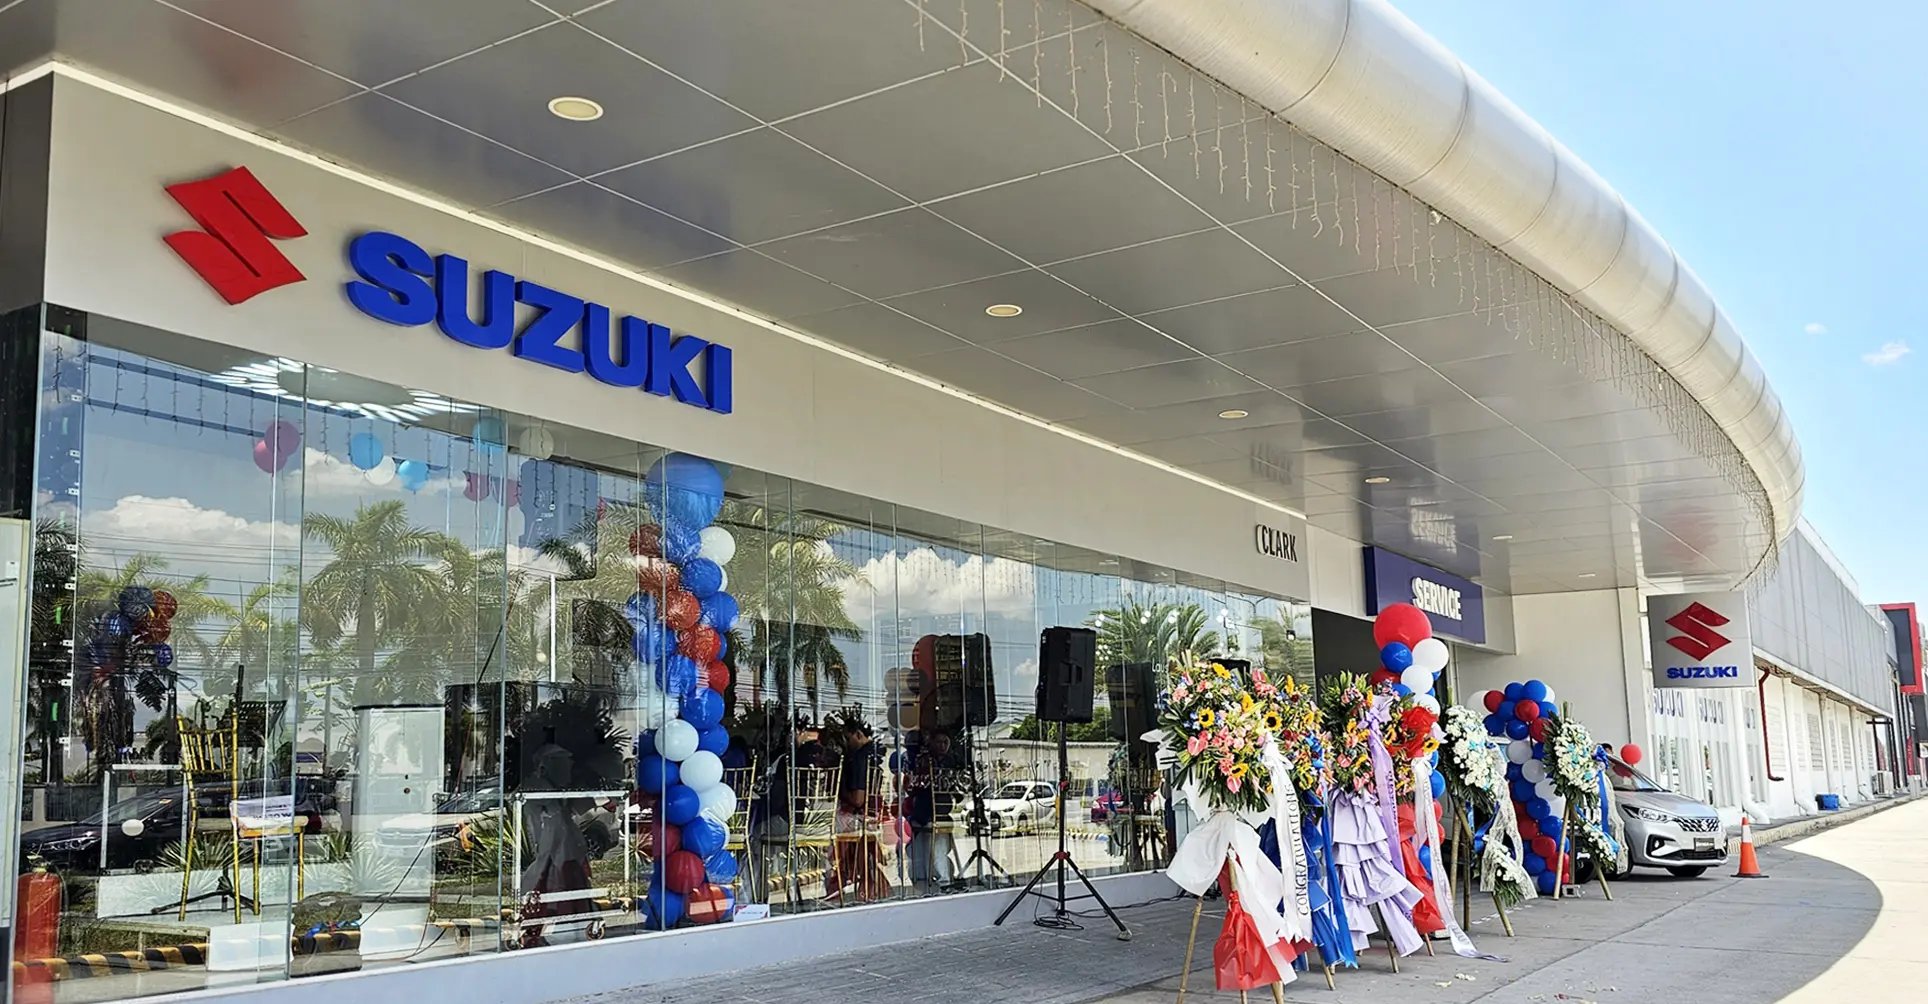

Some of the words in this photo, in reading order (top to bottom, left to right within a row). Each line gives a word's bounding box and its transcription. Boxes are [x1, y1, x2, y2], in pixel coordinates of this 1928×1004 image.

[346, 230, 733, 415] SUZUKI
[1256, 524, 1298, 562] CLARK
[1412, 577, 1462, 621] SERVICE
[1667, 666, 1738, 679] SUZUKI
